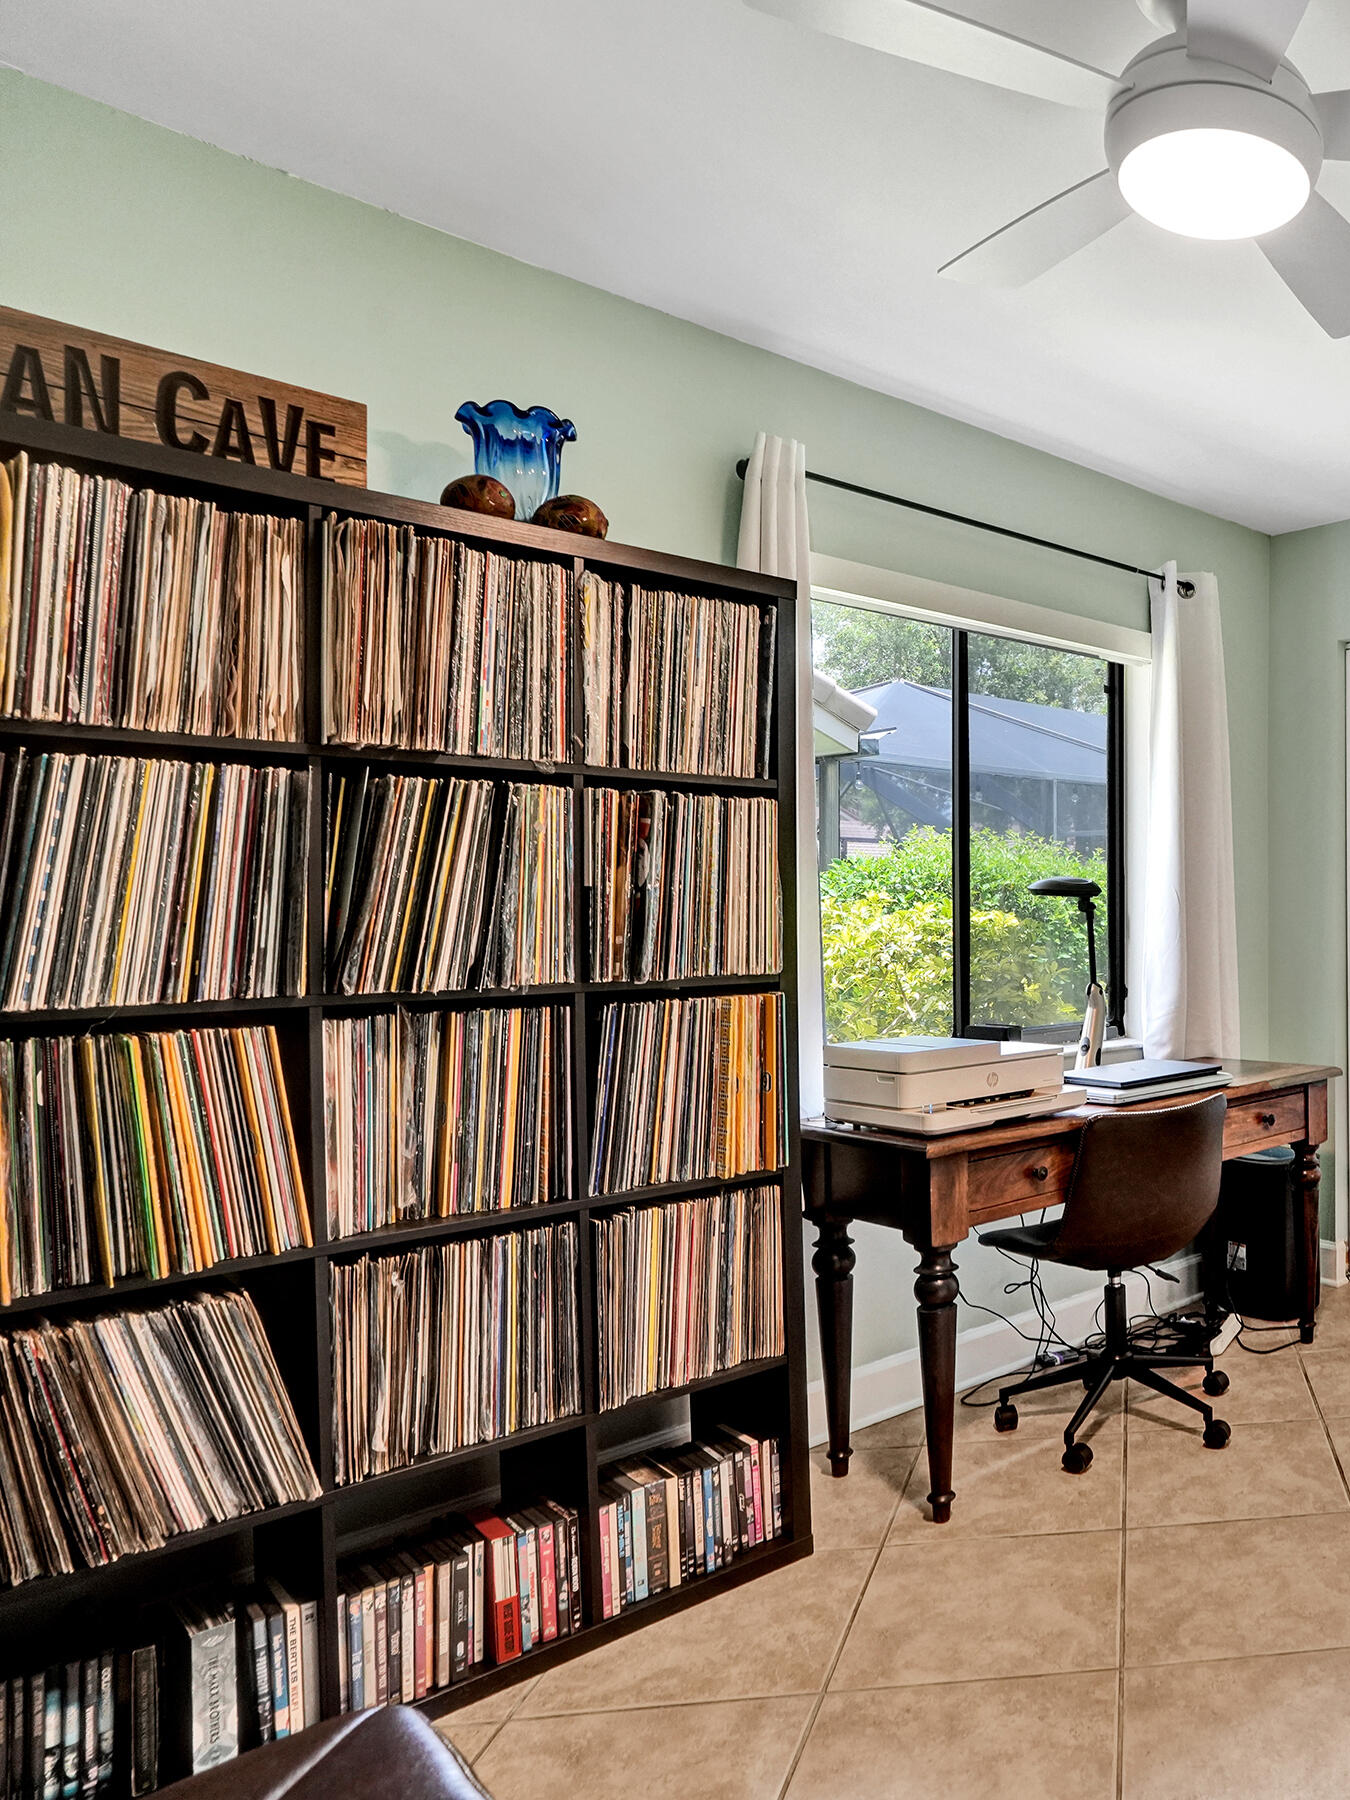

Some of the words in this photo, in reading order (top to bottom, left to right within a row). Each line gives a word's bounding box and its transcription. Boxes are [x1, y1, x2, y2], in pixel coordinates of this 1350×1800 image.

[155, 370, 336, 484] CAVE
[288, 1616, 298, 1637] THE
[289, 1639, 299, 1684] BEATLES
[208, 1671, 221, 1698] MARX
[290, 1685, 300, 1712] HELP!
[209, 1699, 221, 1744] BROTHERS
